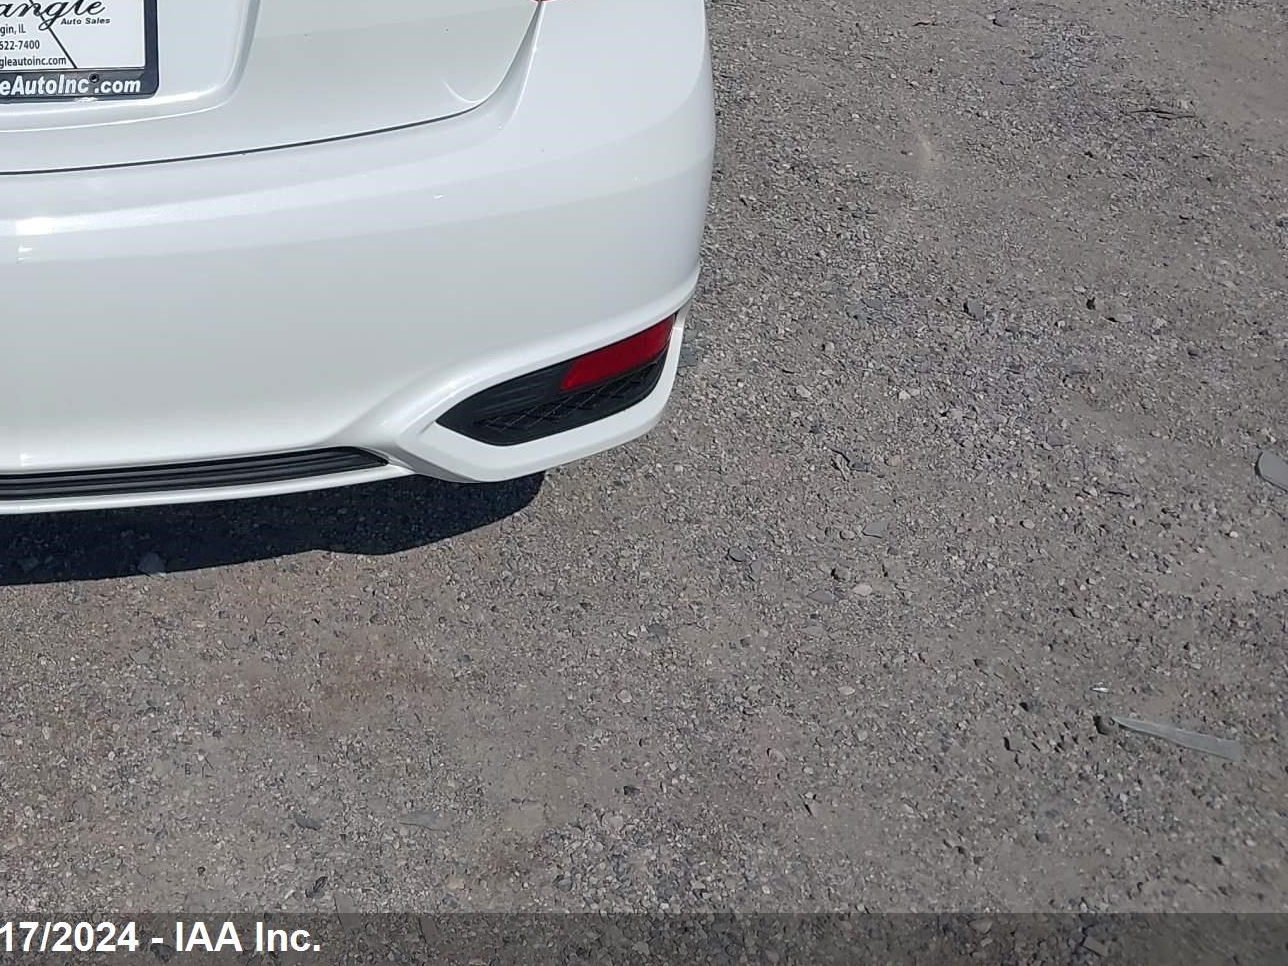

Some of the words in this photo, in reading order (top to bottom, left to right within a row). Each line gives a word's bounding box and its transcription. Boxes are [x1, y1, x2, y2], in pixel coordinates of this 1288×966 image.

[60, 17, 82, 25] Auto
[85, 17, 111, 25] Sales
[18, 23, 27, 34] IL
